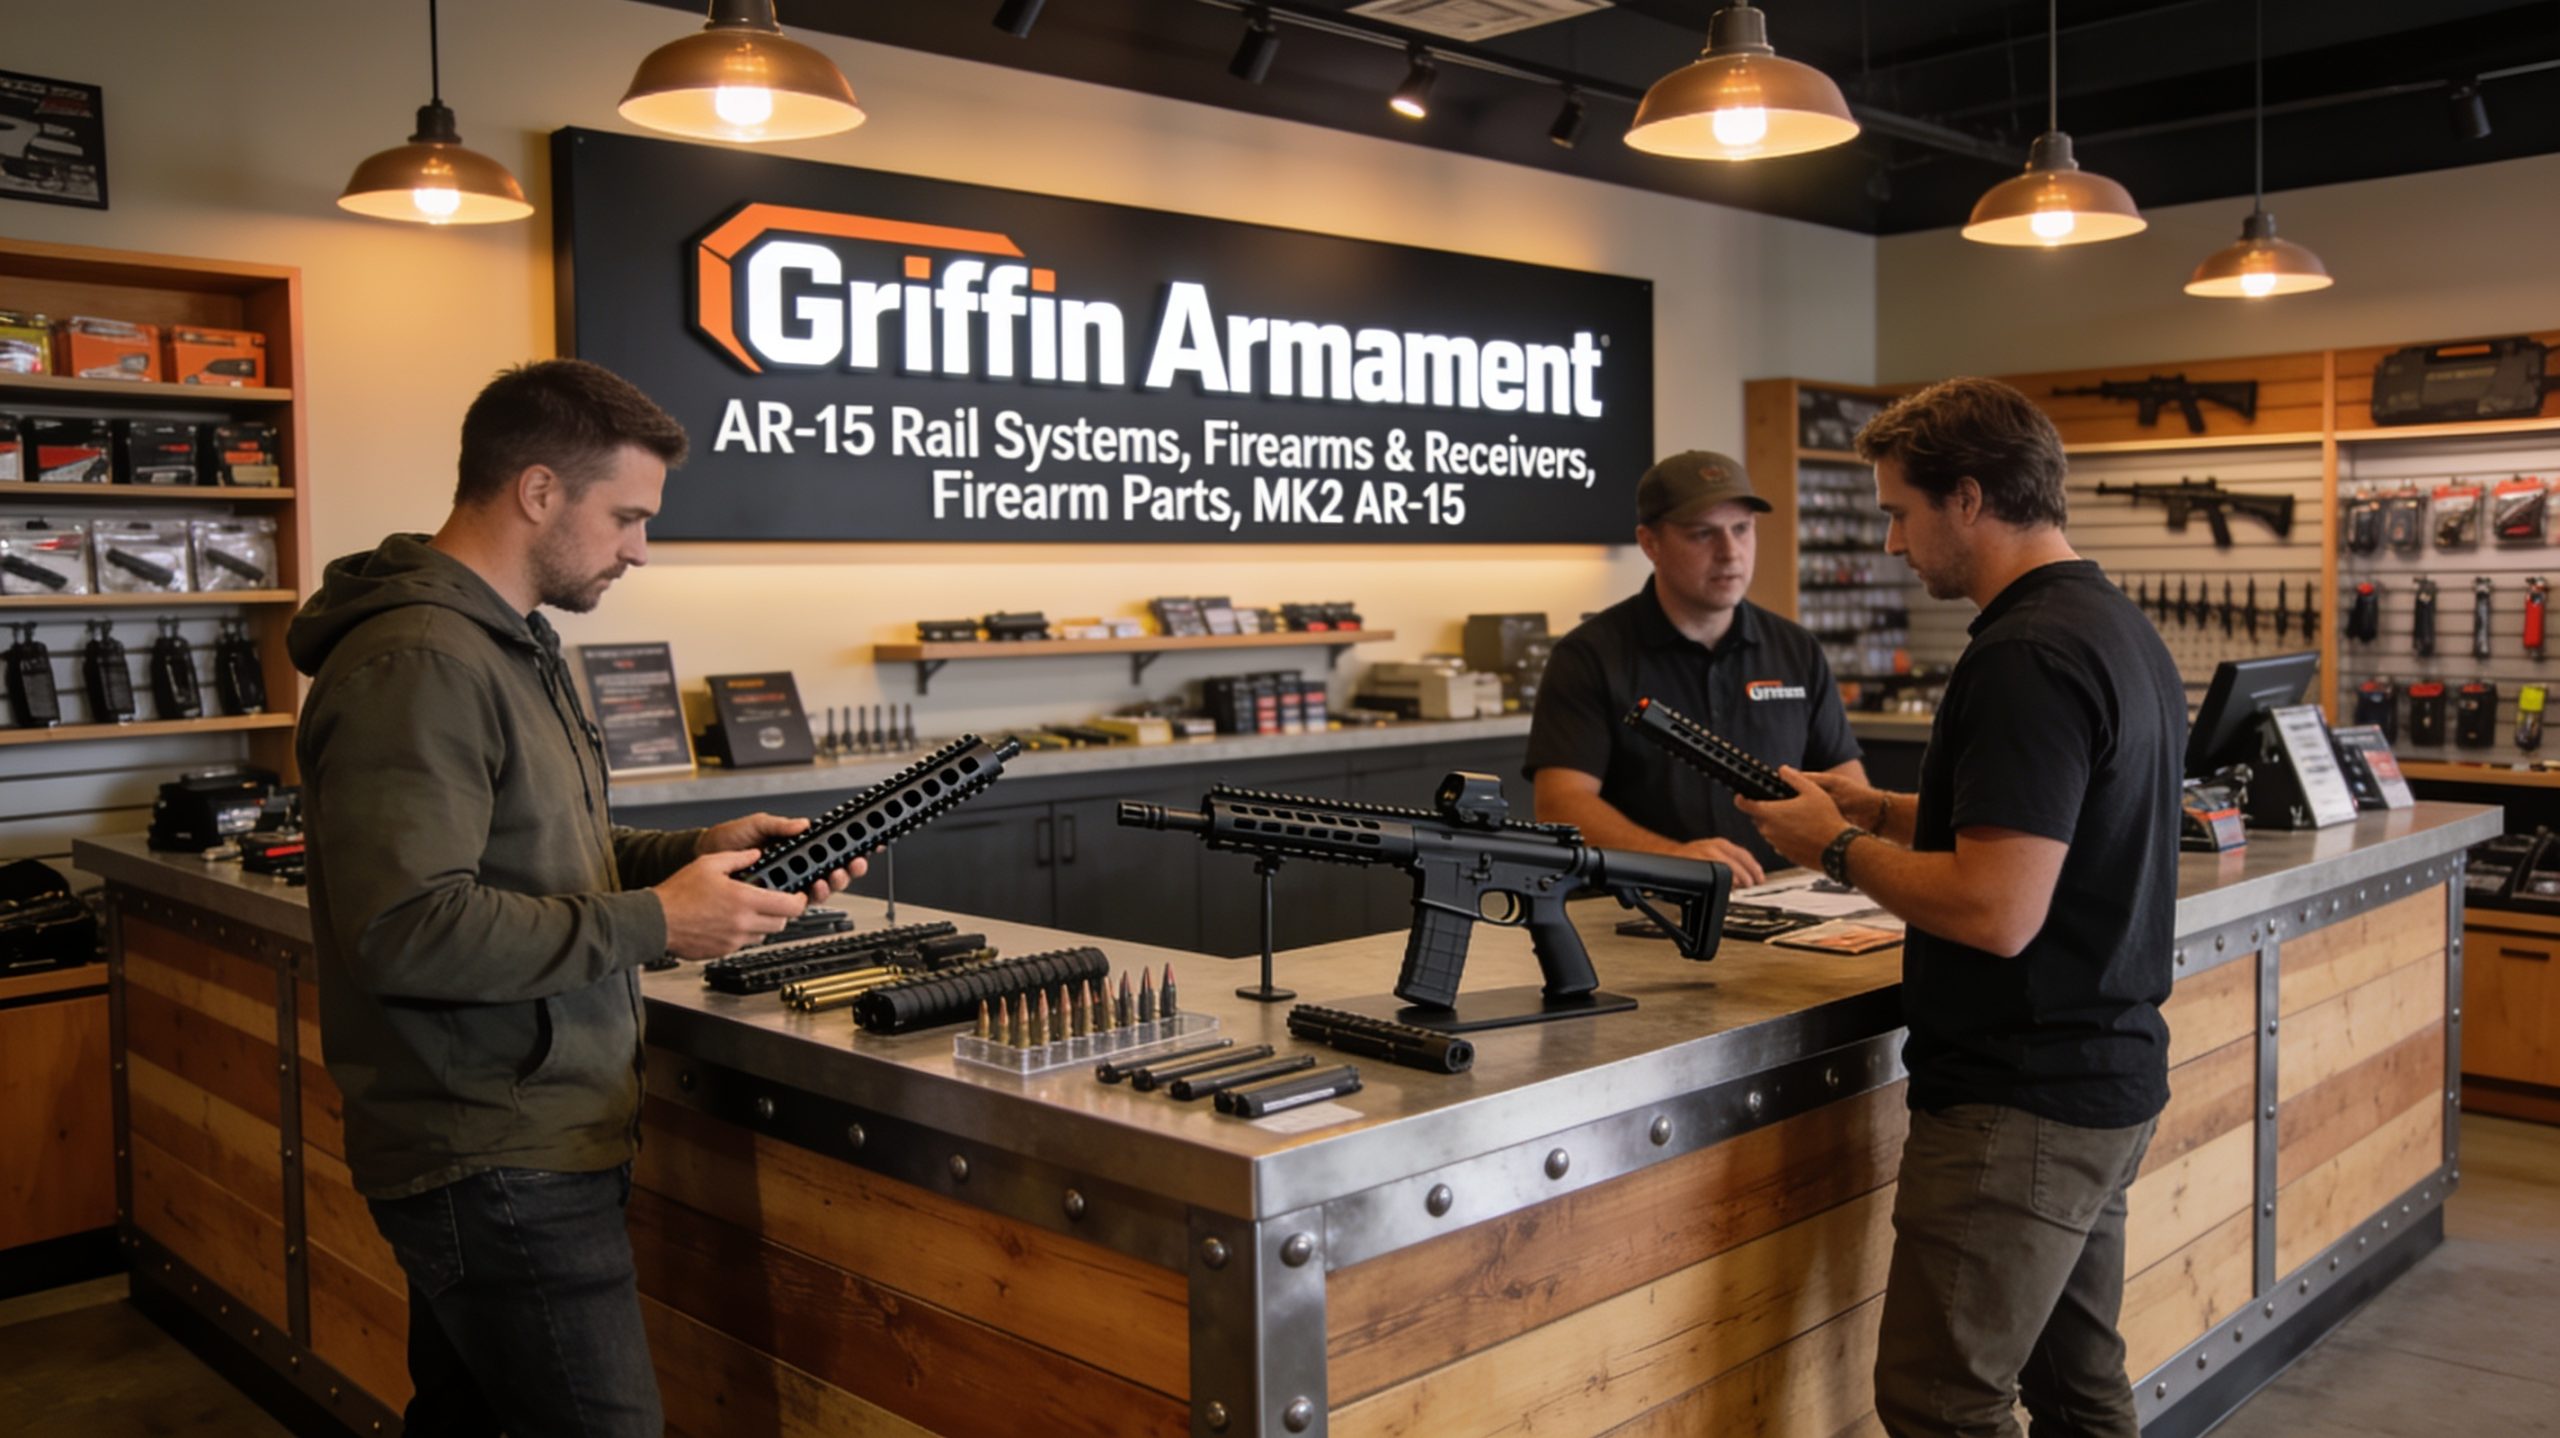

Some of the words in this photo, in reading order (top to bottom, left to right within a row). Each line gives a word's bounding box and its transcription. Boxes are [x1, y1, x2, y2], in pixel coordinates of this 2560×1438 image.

[747, 240, 1126, 386] Griffin
[1144, 281, 1604, 419] Armament
[713, 398, 876, 456] AR-15
[891, 403, 980, 460] Rail
[994, 410, 1191, 474] Systems,
[1204, 419, 1375, 471] Firearms
[1384, 428, 1415, 472] &
[1425, 430, 1596, 488] Receivers,
[932, 469, 1109, 521] Firearm
[1123, 473, 1242, 532] Parts,
[1253, 476, 1344, 524] MK2
[1353, 480, 1466, 526] AR-15
